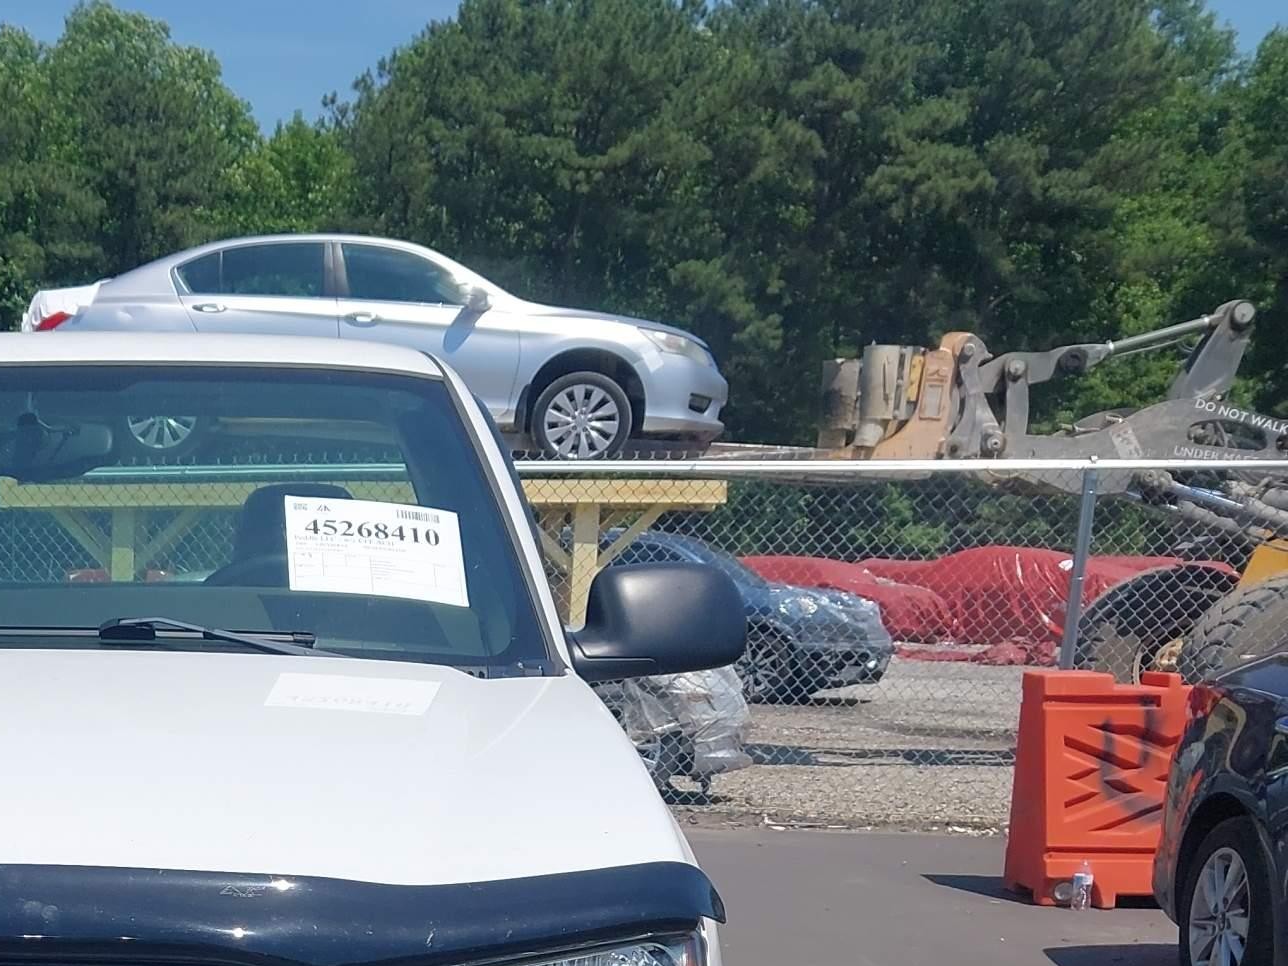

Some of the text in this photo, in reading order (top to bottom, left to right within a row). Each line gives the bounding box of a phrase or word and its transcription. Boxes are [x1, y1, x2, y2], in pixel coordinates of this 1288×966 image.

[1195, 399, 1288, 434] DO NOT WALK
[304, 518, 440, 547] 45268410
